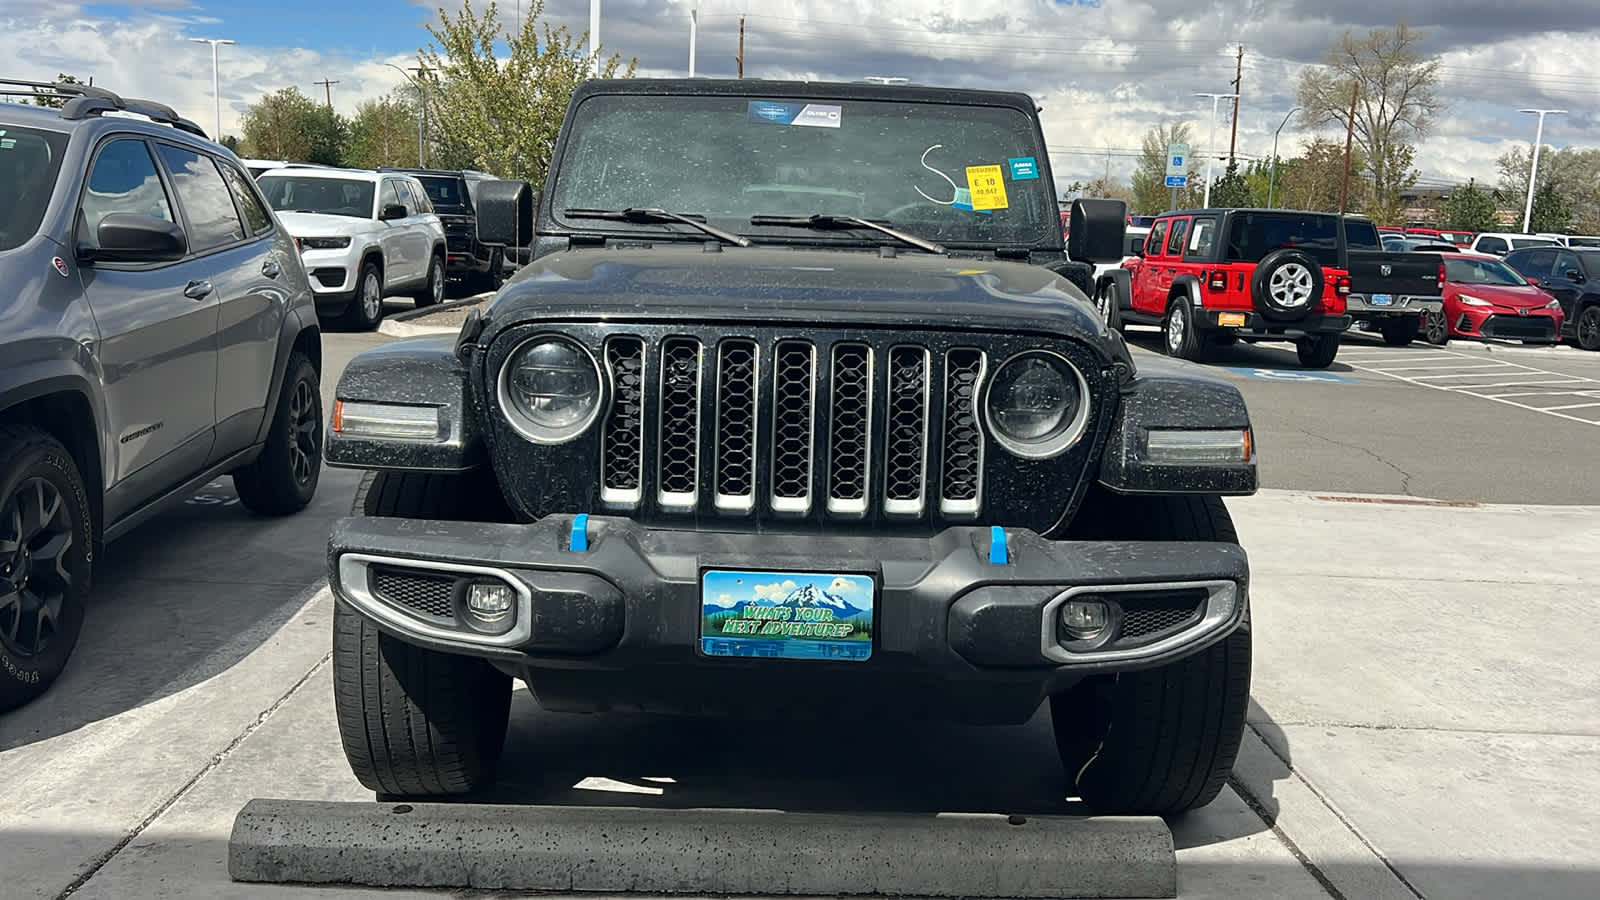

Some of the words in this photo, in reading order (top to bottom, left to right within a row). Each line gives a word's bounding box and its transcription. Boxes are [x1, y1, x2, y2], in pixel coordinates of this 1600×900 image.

[743, 605, 791, 621] WHAT'S
[794, 607, 833, 622] YOUR
[722, 620, 762, 634] NEXT
[761, 620, 854, 638] ADVENTURE?
